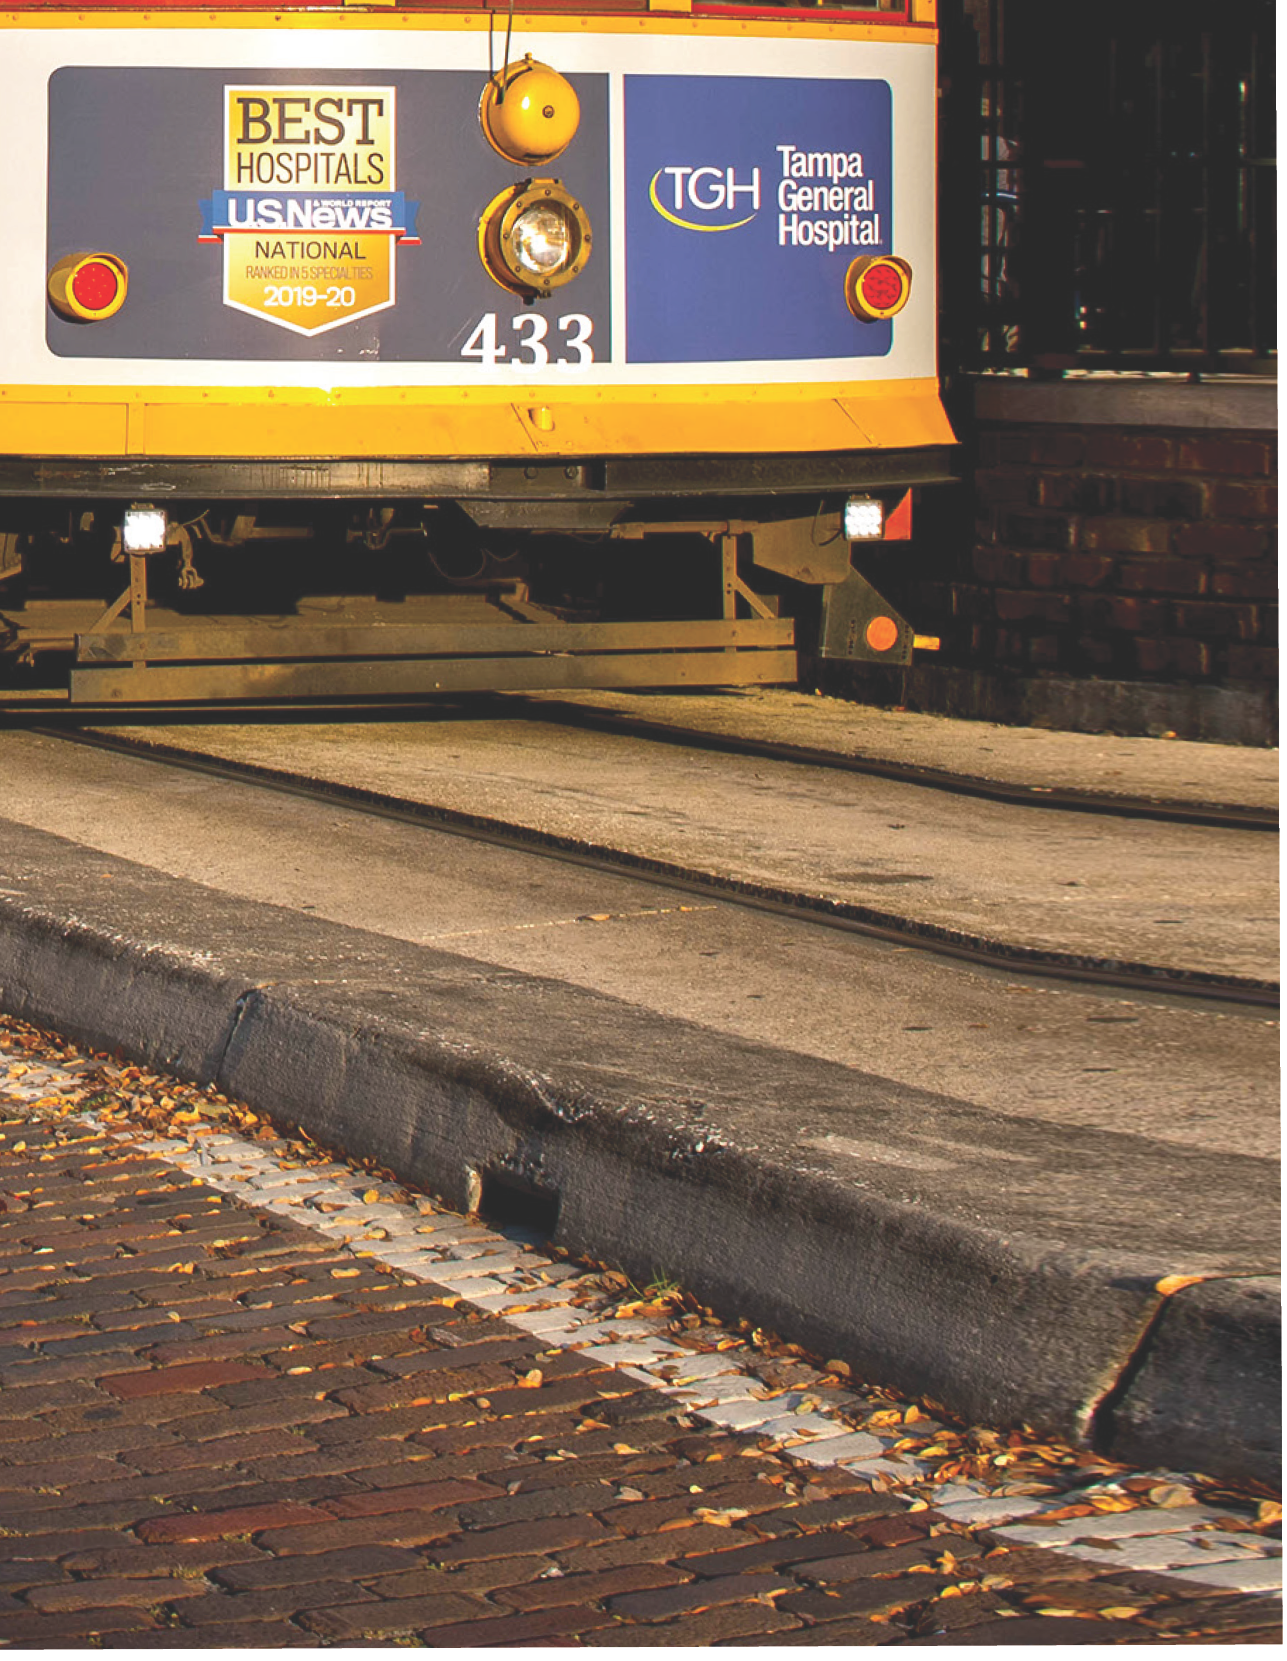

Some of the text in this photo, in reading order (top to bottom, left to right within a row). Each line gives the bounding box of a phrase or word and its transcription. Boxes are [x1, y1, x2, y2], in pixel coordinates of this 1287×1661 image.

[236, 97, 385, 146] BEST
[236, 151, 385, 185] HOSPITALS
[775, 144, 864, 184] Tampa
[321, 199, 354, 208] WORLD
[355, 199, 392, 208] REPORT
[664, 166, 761, 210] TGH
[777, 179, 875, 212] General
[778, 213, 880, 252] Hospital
[254, 240, 367, 260] NATIONAL
[245, 265, 374, 280] RANKED IN 5 SPECIALTIES
[263, 285, 356, 308] 2019-20
[460, 312, 595, 373] 433
